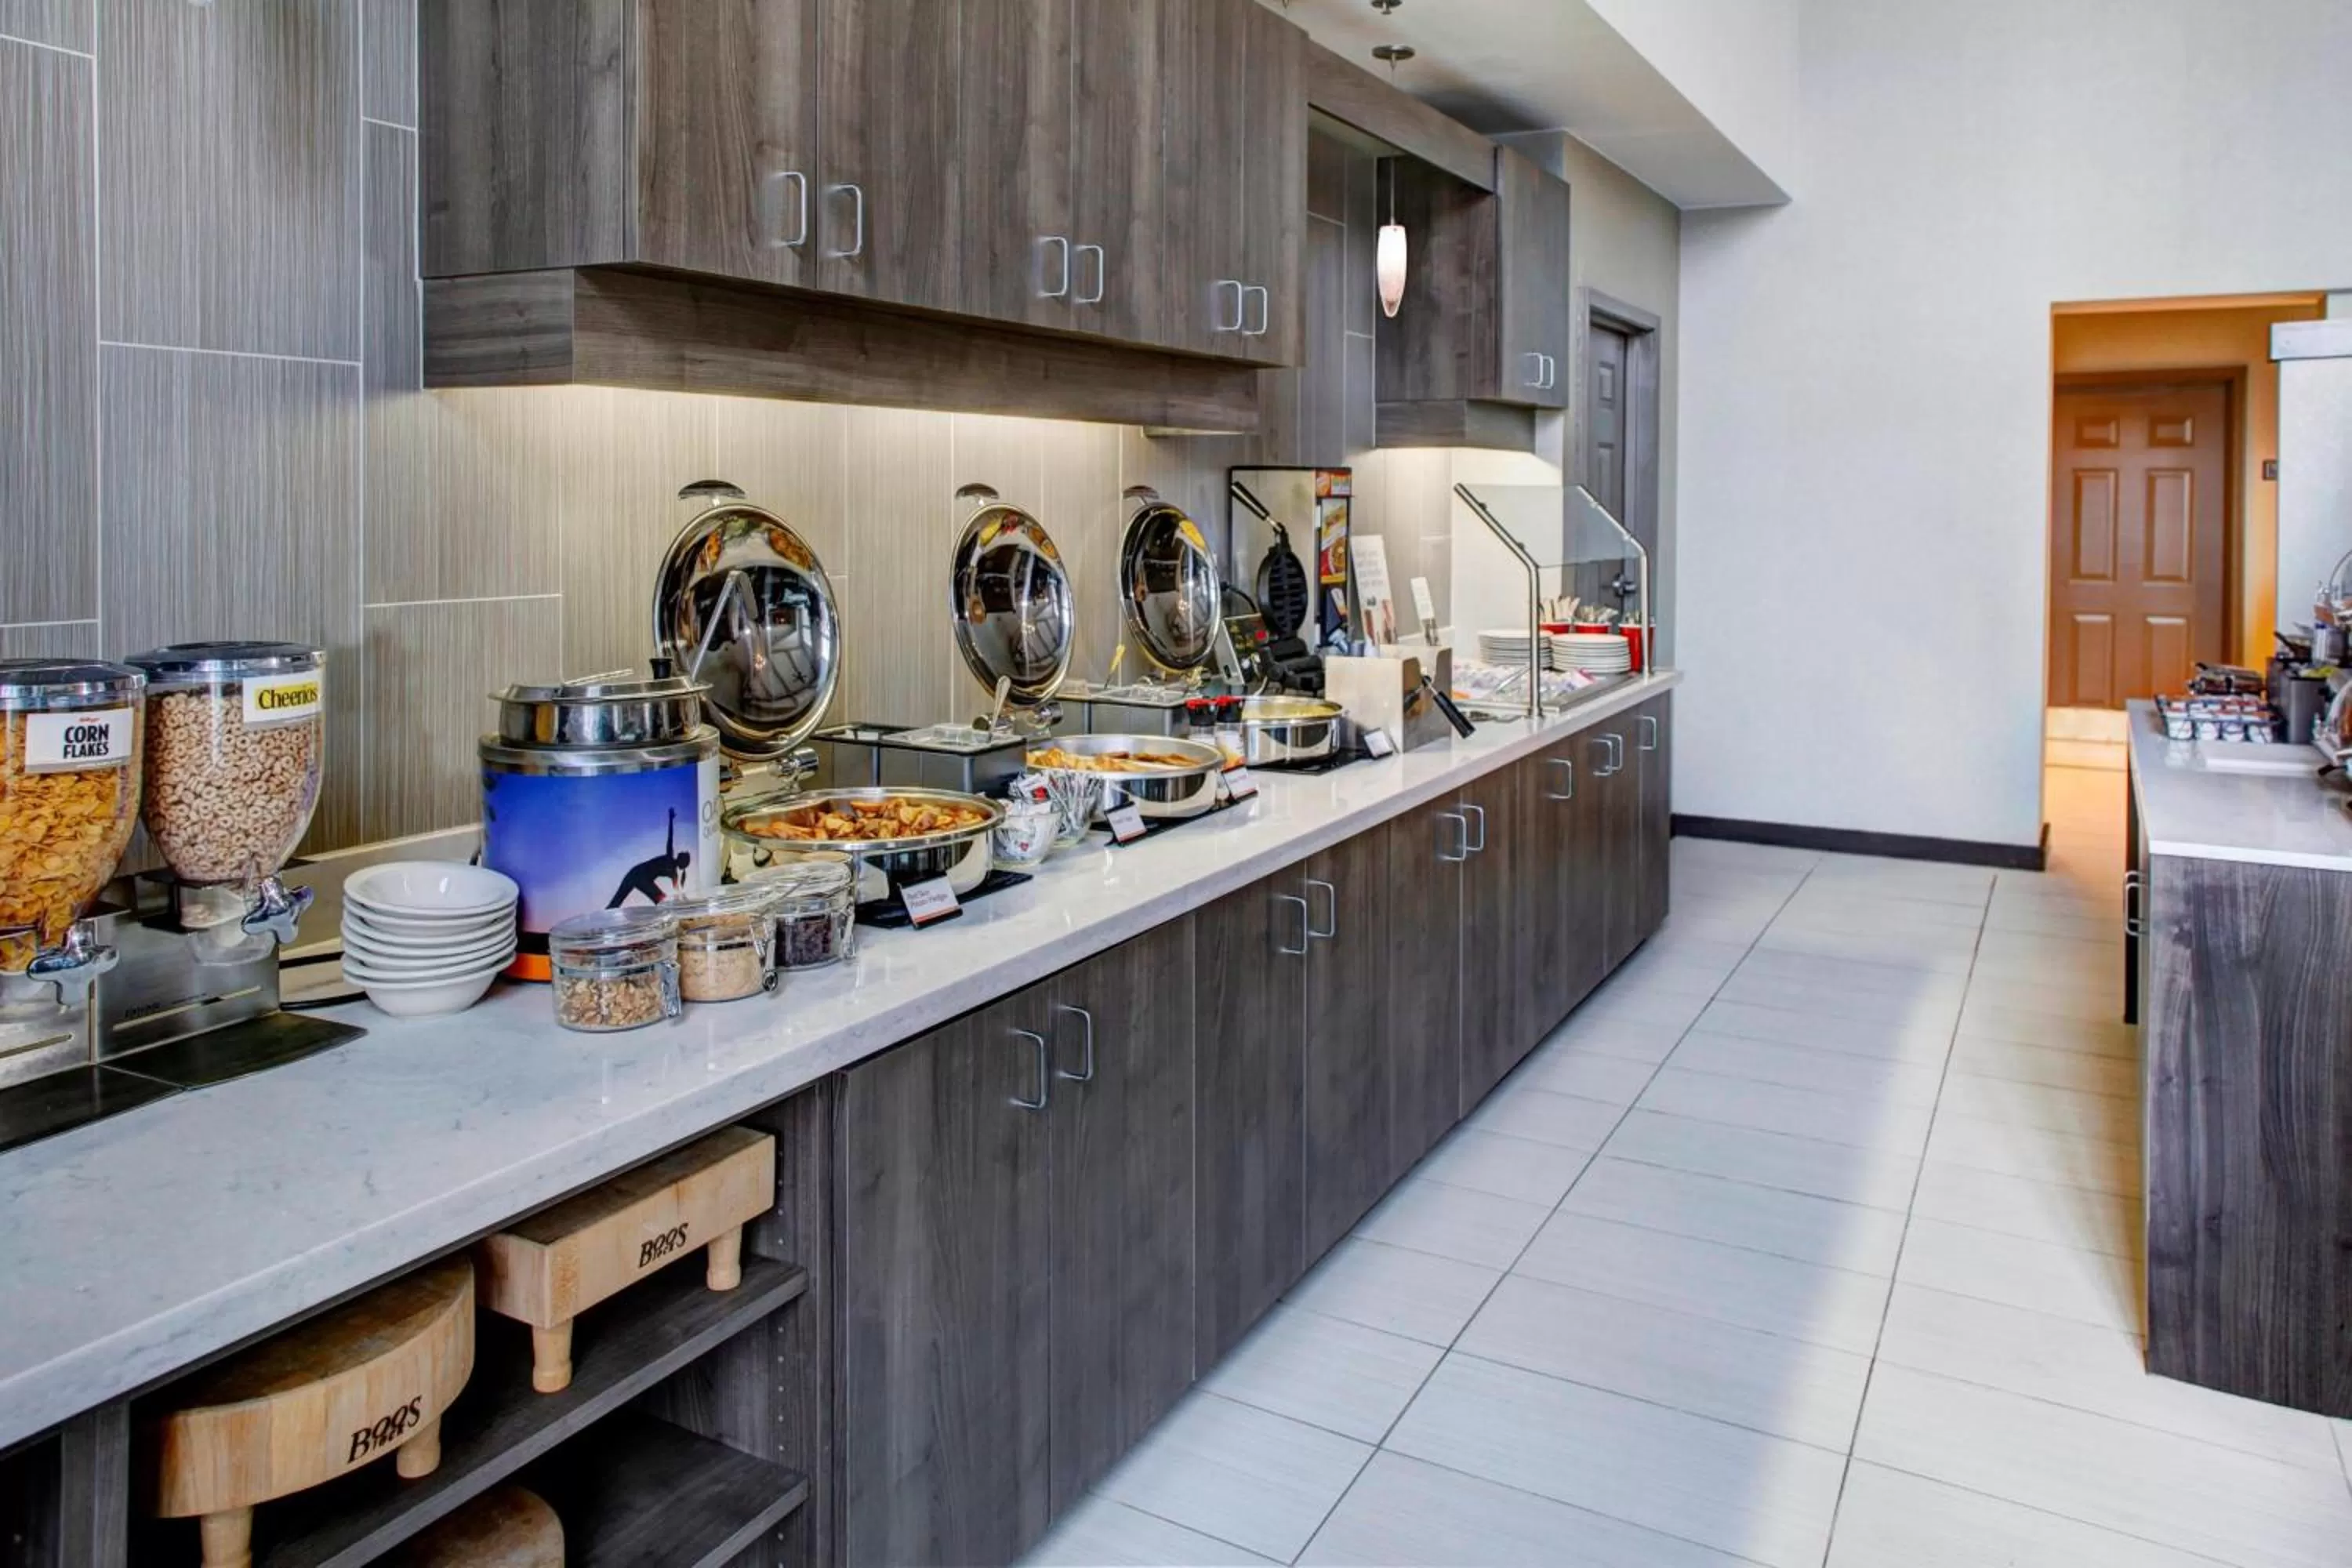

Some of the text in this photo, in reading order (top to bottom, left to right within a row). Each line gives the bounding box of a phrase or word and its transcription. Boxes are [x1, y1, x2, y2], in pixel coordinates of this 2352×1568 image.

[63, 741, 109, 759] FLAKES
[64, 724, 109, 743] CORN
[639, 1222, 689, 1269] BOOS
[347, 1395, 422, 1465] BOOS
